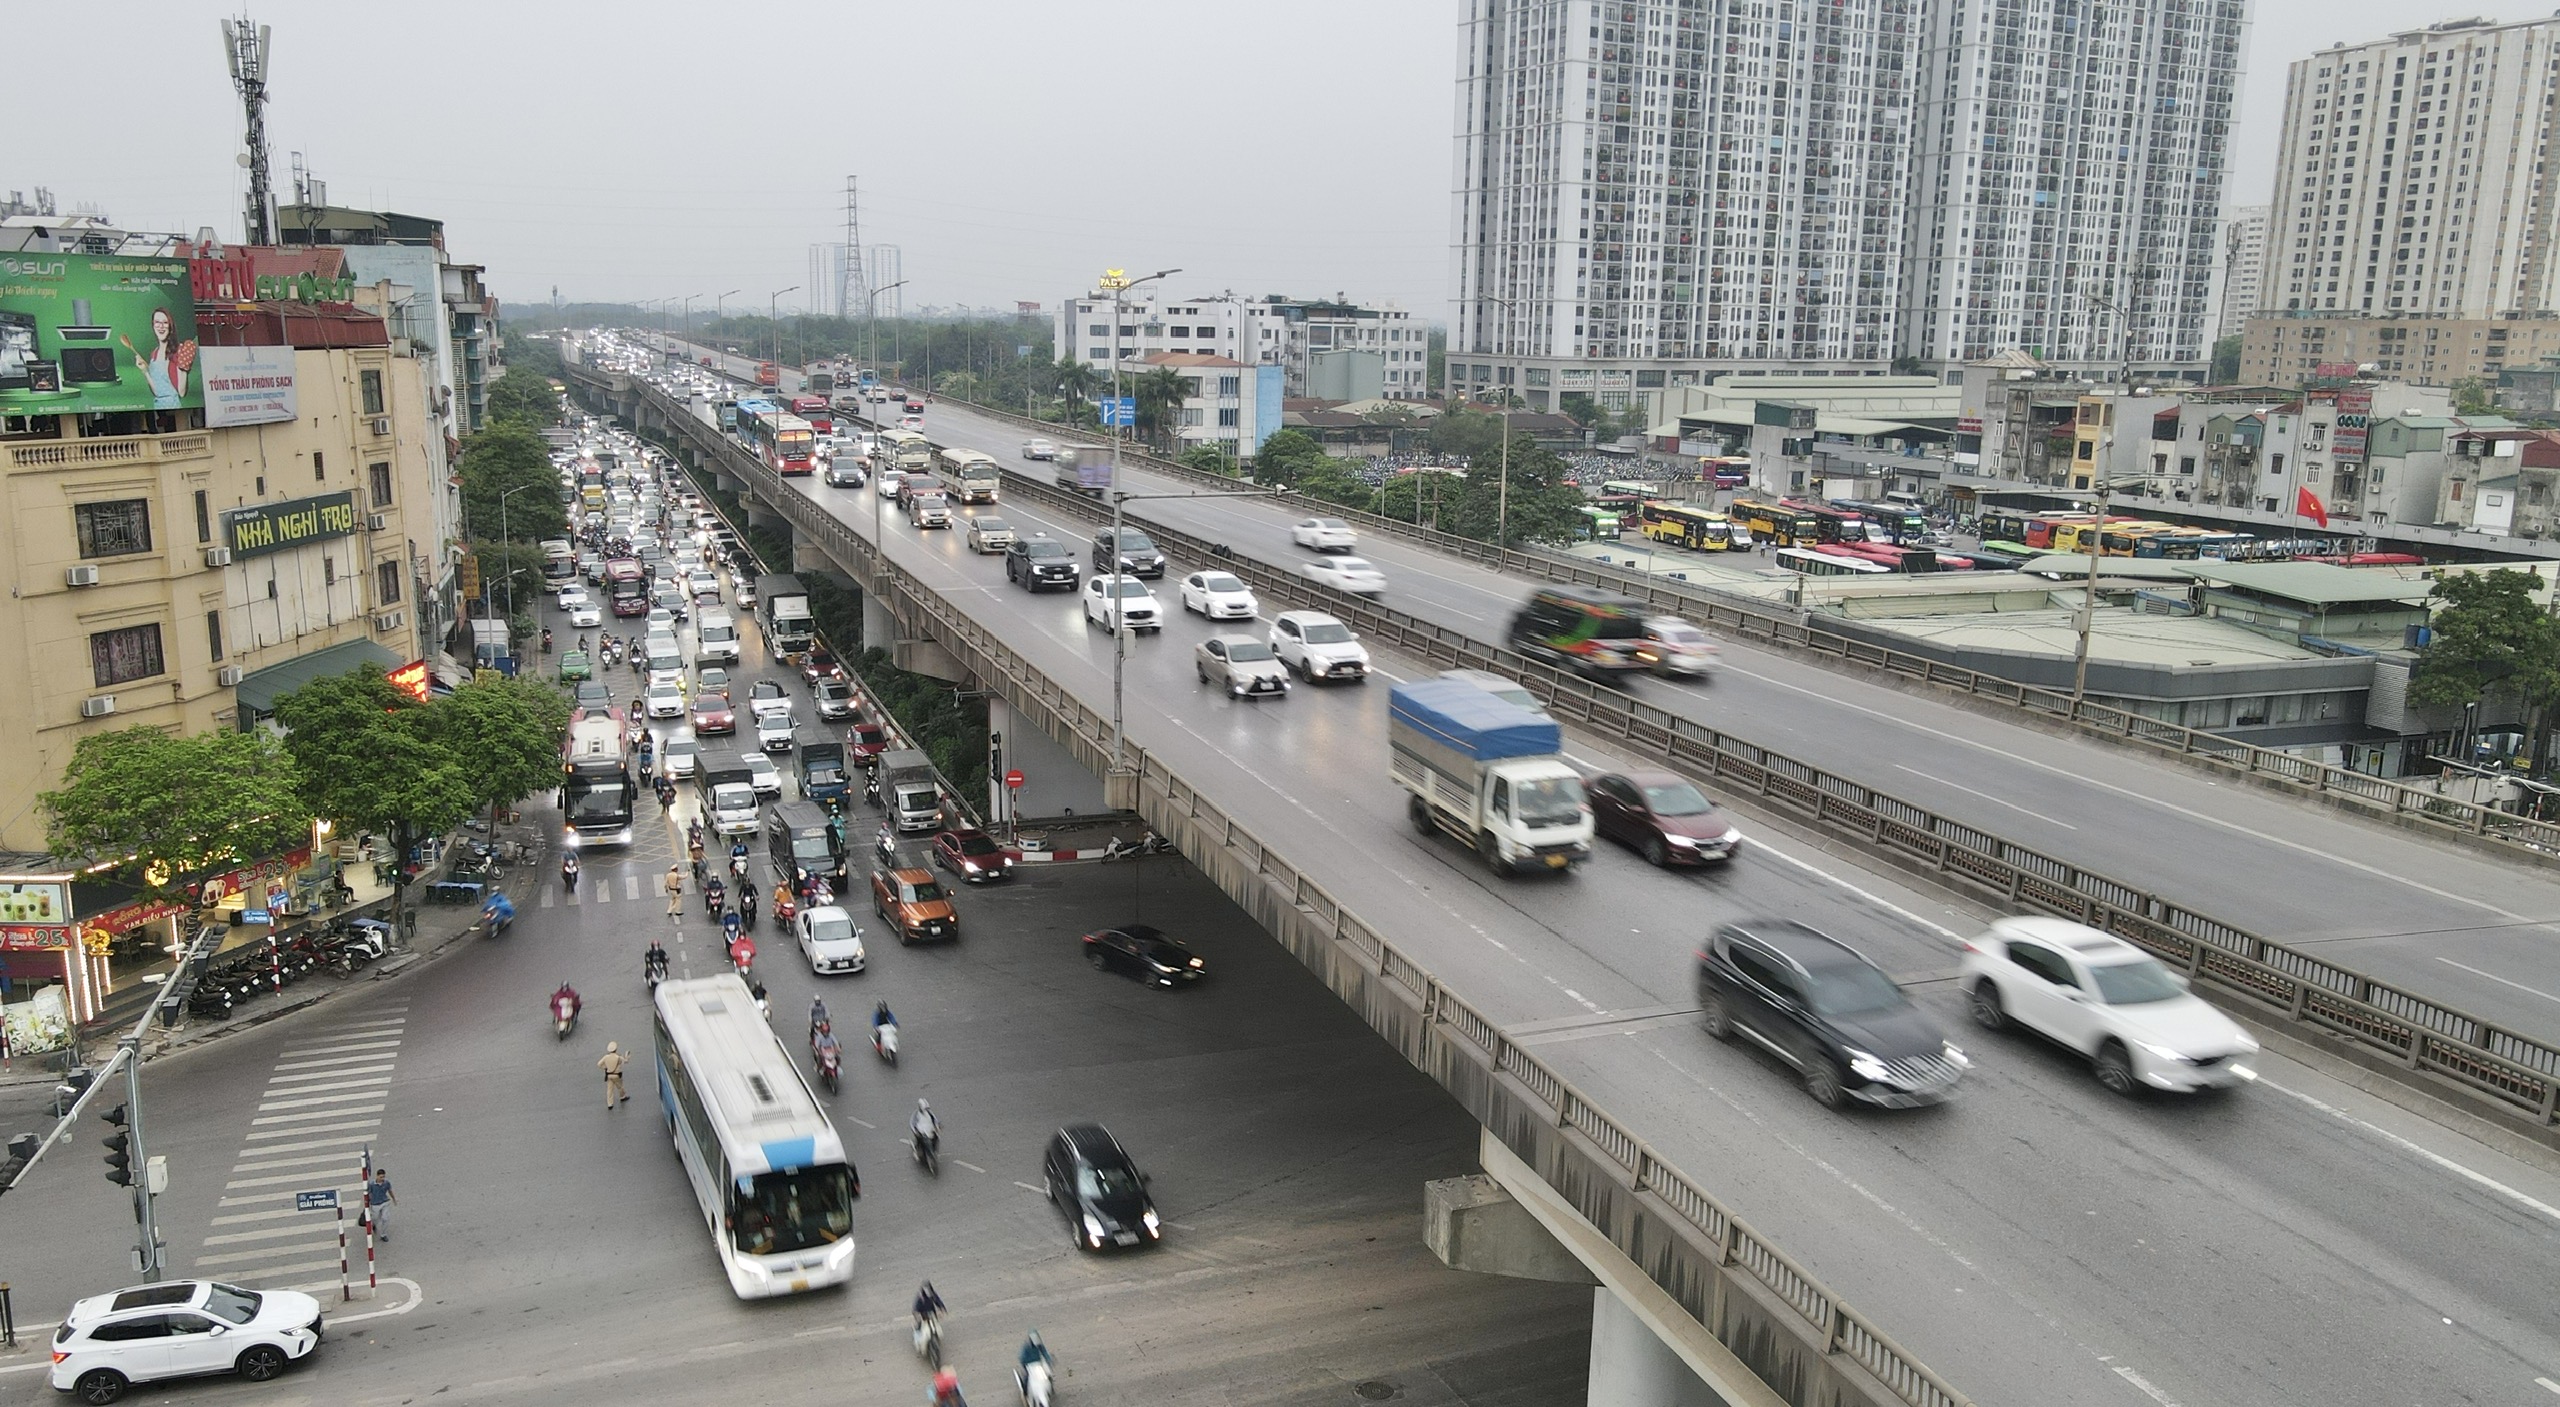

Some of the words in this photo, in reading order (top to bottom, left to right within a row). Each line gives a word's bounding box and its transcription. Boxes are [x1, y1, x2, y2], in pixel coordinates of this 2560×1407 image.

[209, 375, 230, 391] TỔNG
[252, 375, 274, 389] PHÒNG
[236, 514, 274, 550] NHÀ
[278, 502, 318, 542] NGHỈ
[322, 504, 352, 534] TRỌ
[300, 1198, 312, 1208] GIẢI
[314, 1198, 335, 1207] PHÓNG
